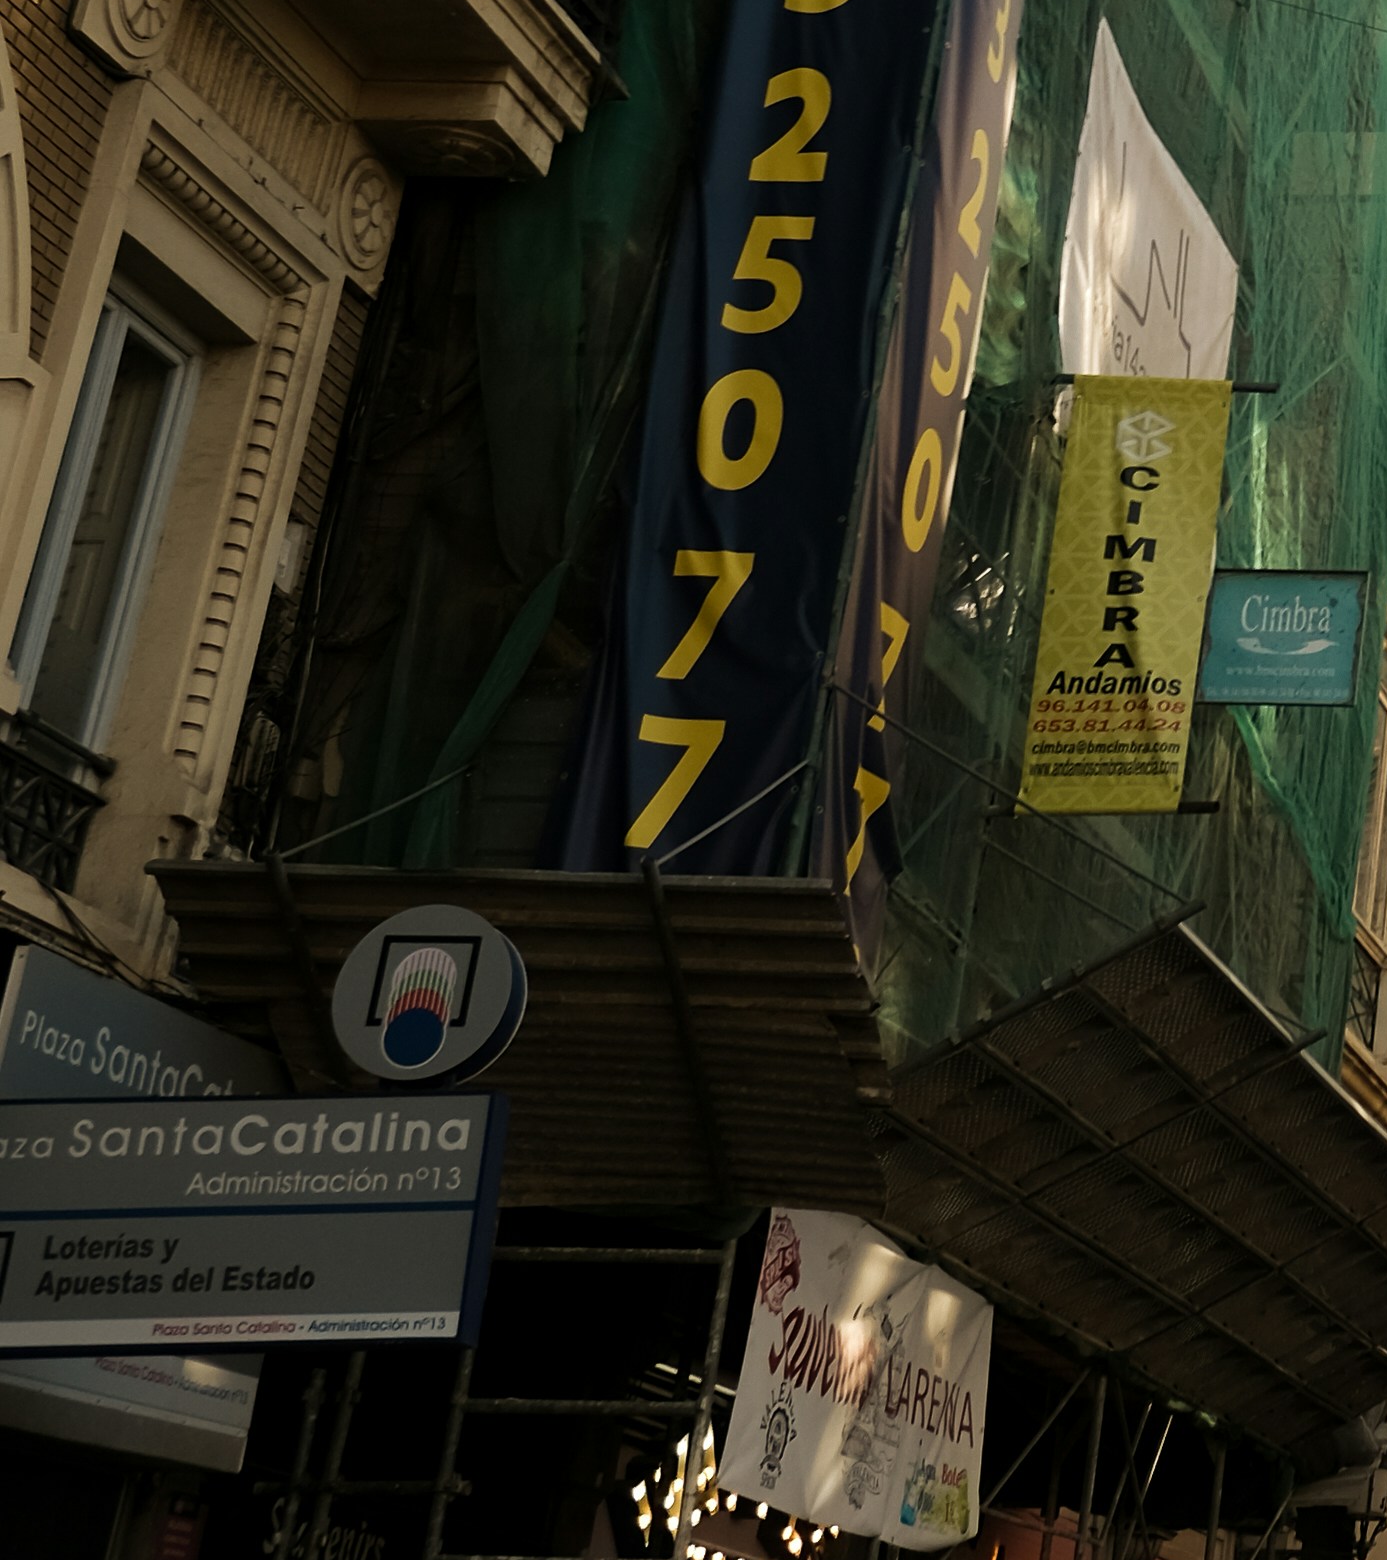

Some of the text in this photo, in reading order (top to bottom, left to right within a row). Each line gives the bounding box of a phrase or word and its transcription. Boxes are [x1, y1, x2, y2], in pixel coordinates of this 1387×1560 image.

[1093, 465, 1161, 669] CIMBRA
[1240, 594, 1332, 635] Cimbra
[1046, 670, 1182, 696] Andamios
[1036, 699, 1186, 714] 96.141.04.08
[1032, 718, 1182, 733] 653.81.44.24
[1031, 740, 1180, 755] cimbra@bmcimbra.com
[20, 1009, 86, 1068] Plaza
[67, 1111, 472, 1159] SantaCatalina
[186, 1168, 388, 1197] Administración
[44, 1232, 180, 1263] Loterías y
[35, 1265, 316, 1301] Apuestas del Estado
[152, 1322, 188, 1336] Plaza
